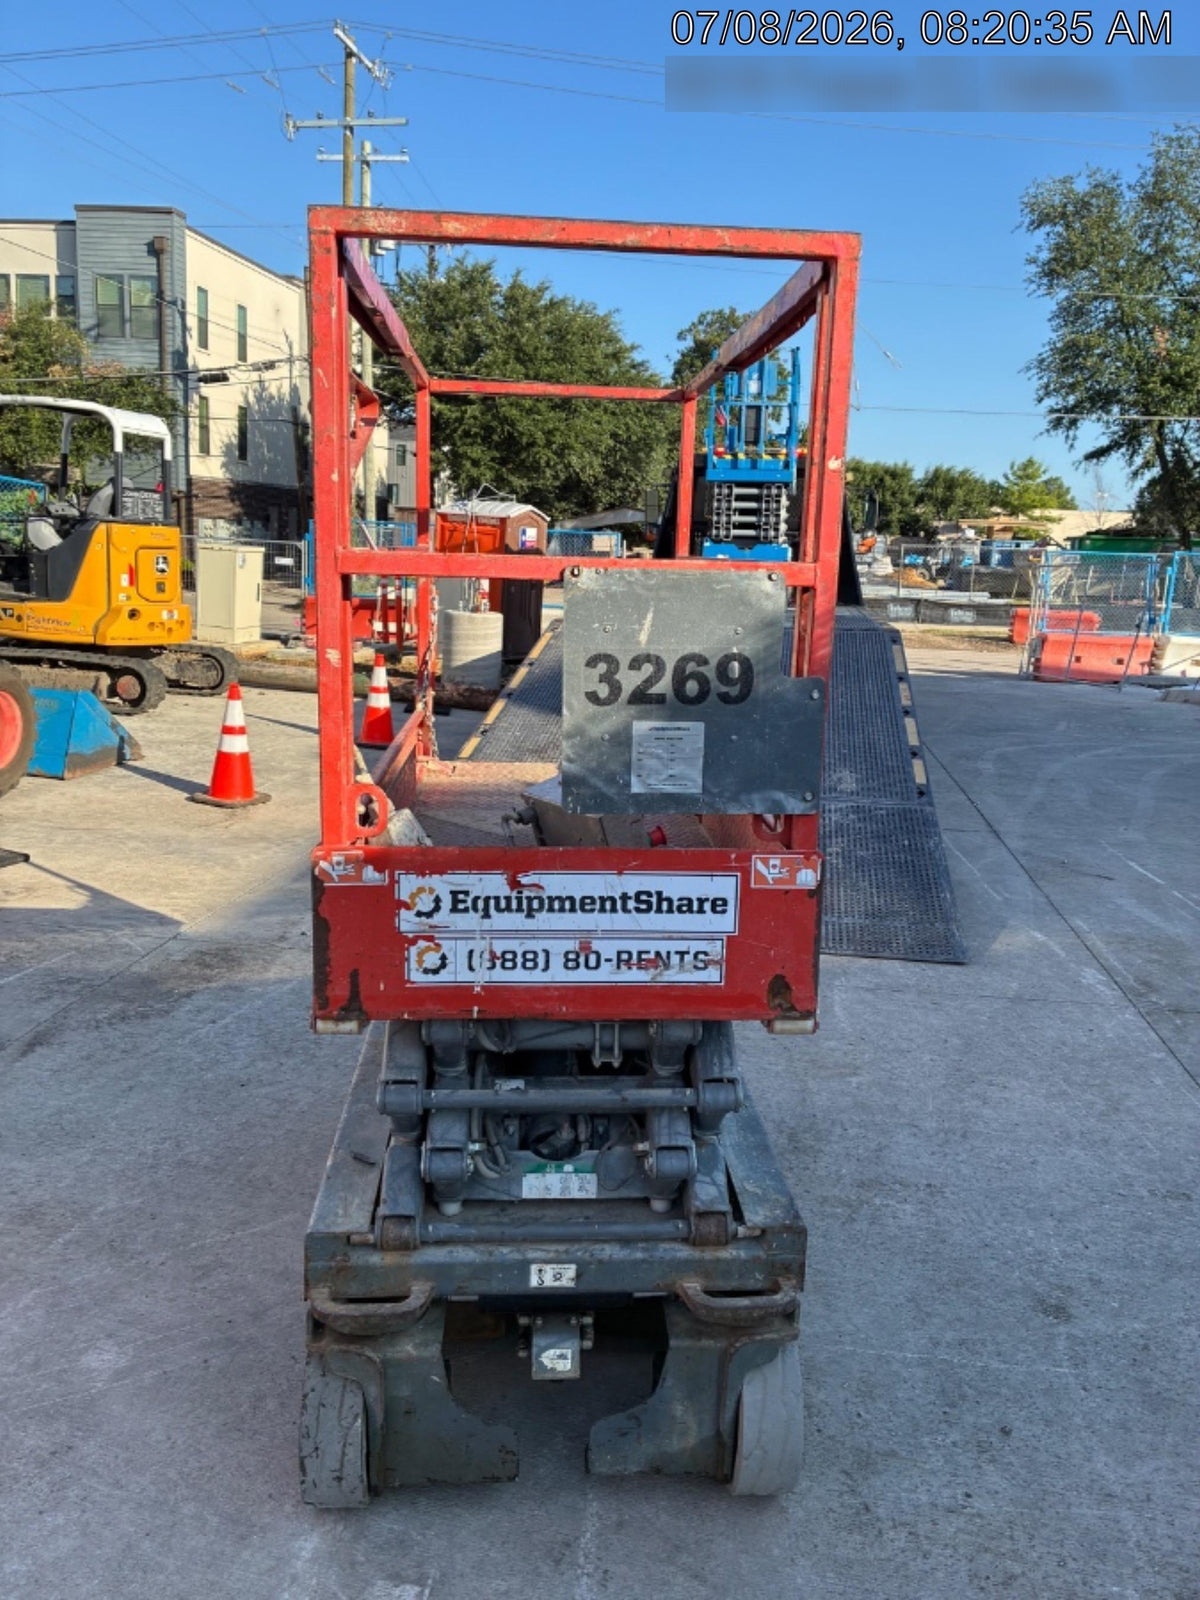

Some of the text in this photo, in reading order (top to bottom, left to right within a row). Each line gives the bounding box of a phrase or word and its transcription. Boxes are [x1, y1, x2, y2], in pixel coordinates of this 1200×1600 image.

[584, 652, 755, 706] 3269
[449, 889, 729, 919] EquipmentShare
[563, 949, 710, 972] 80-RENTS
